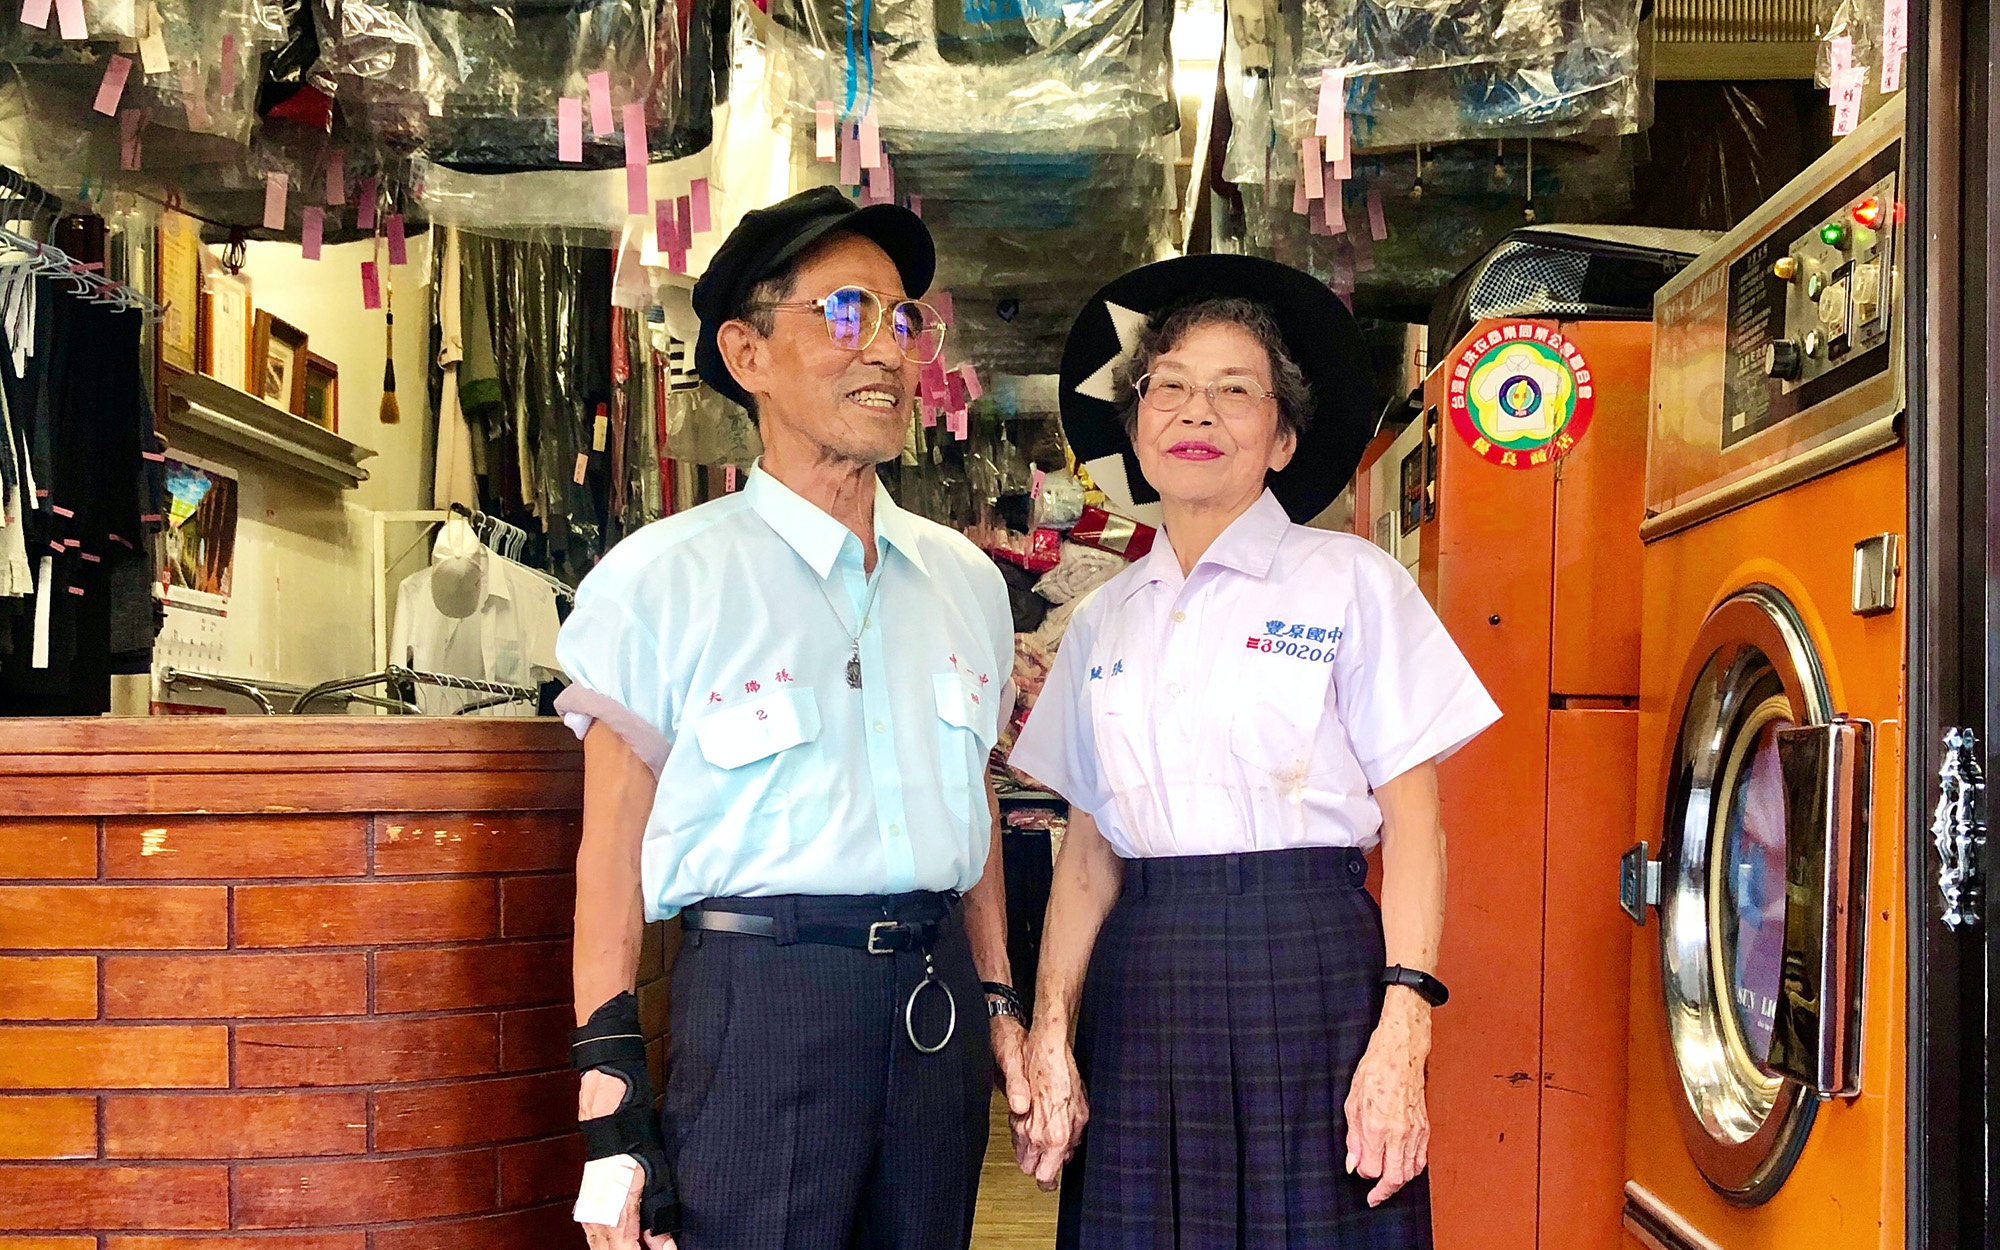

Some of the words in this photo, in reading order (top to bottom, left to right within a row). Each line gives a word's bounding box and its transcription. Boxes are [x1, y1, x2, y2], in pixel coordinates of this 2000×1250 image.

[1263, 619, 1343, 644] 豐原國中
[756, 709, 768, 721] 2
[1737, 987, 1756, 1010] SUN
